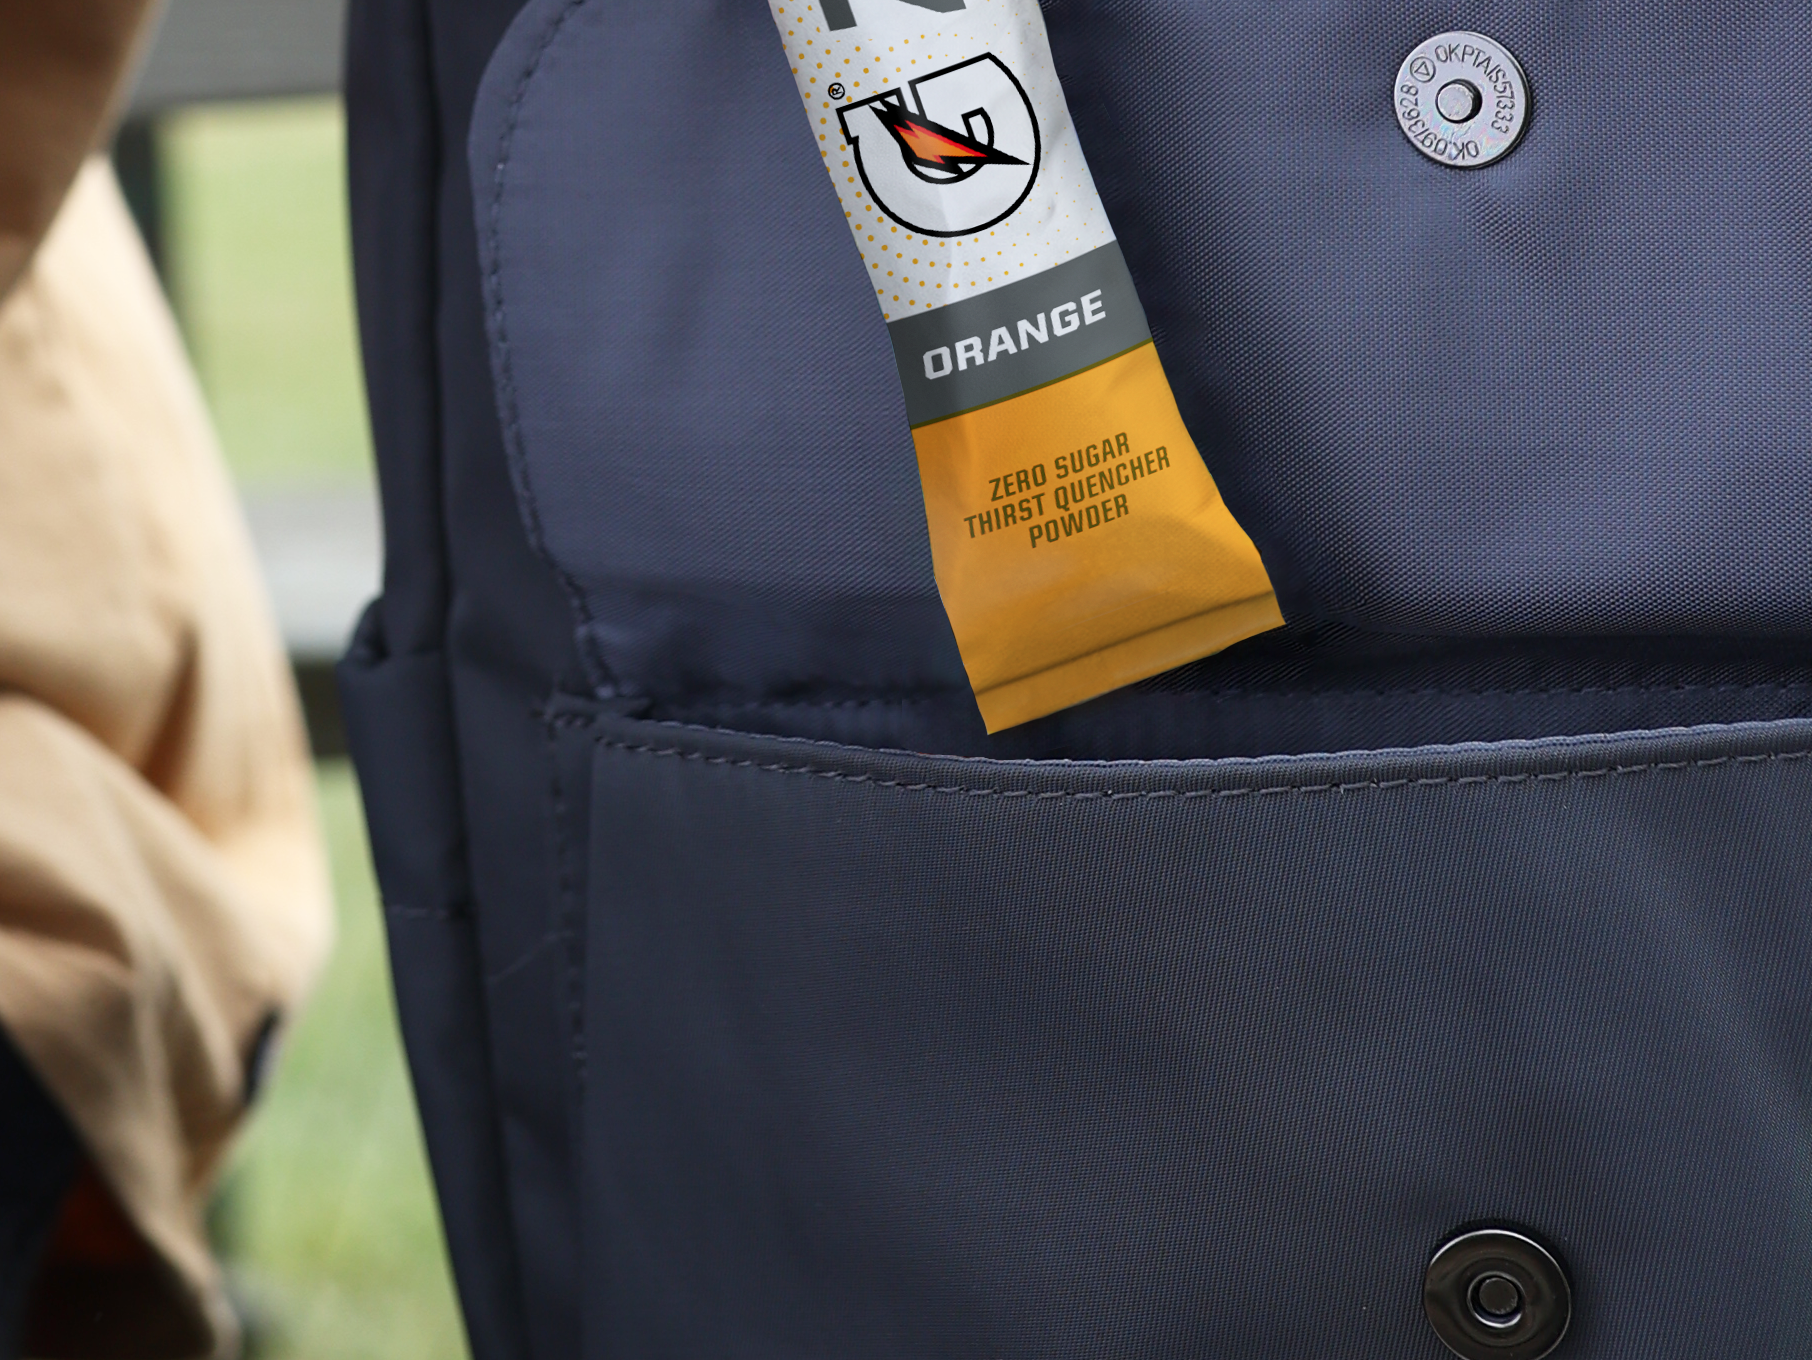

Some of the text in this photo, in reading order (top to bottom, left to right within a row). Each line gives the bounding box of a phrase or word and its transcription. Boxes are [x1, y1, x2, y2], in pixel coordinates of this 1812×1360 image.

[922, 288, 1107, 381] ORANGE
[963, 445, 1171, 539] THIRST QUENCHER
[988, 431, 1131, 502] ZERO SUGAR
[1028, 493, 1130, 549] POWDER
